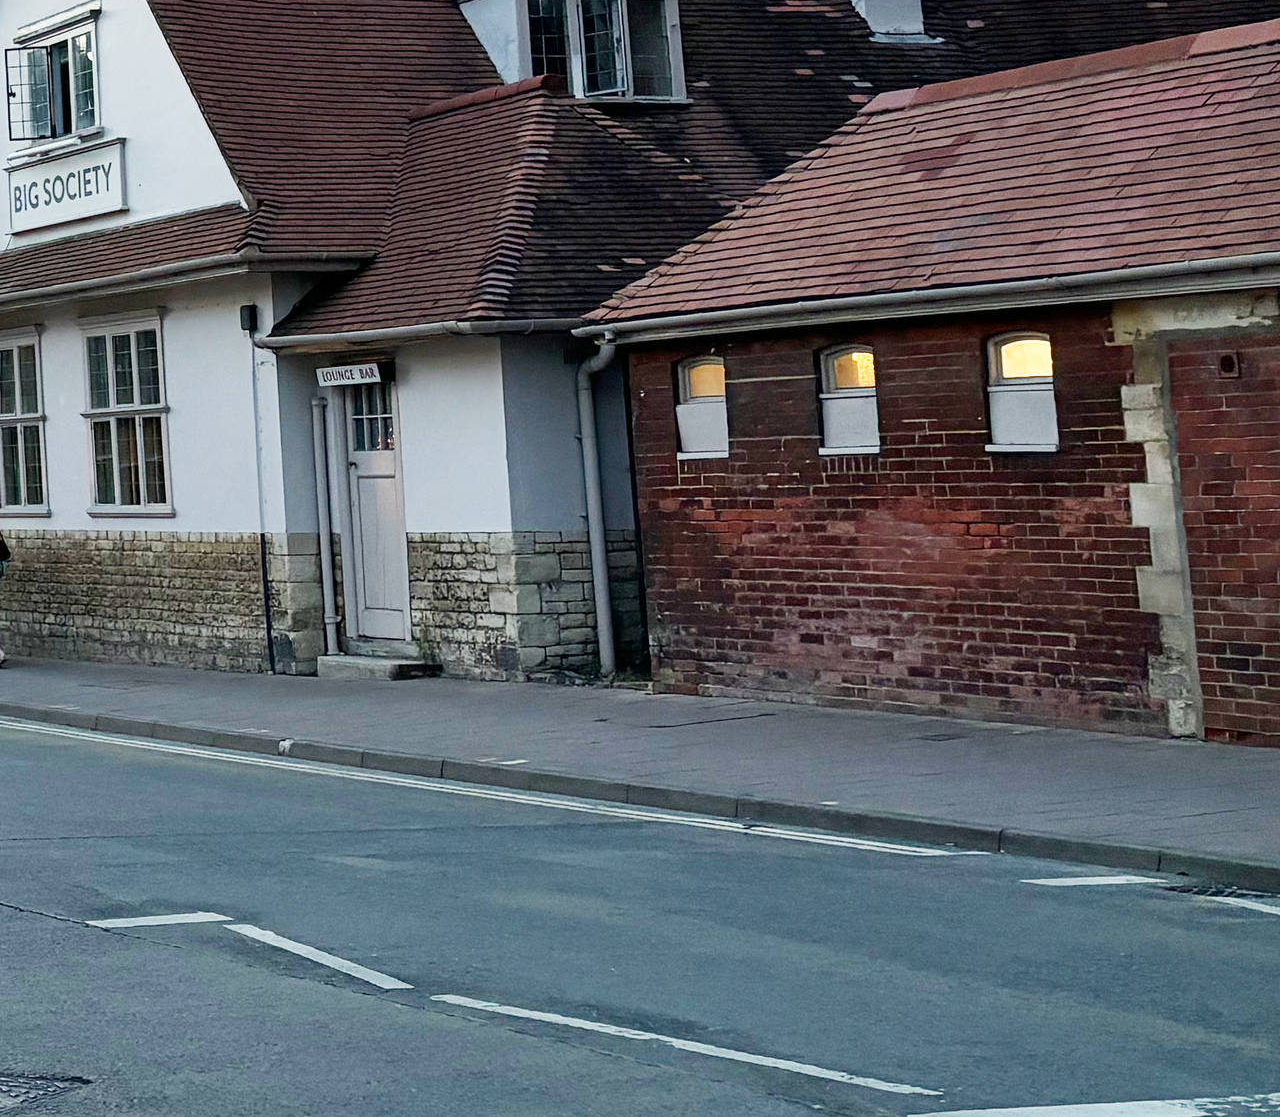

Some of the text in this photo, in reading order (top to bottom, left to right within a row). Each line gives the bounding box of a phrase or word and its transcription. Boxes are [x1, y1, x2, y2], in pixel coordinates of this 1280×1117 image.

[14, 162, 112, 213] BIG SOCIETY
[322, 367, 376, 382] LOUNGE BAR
